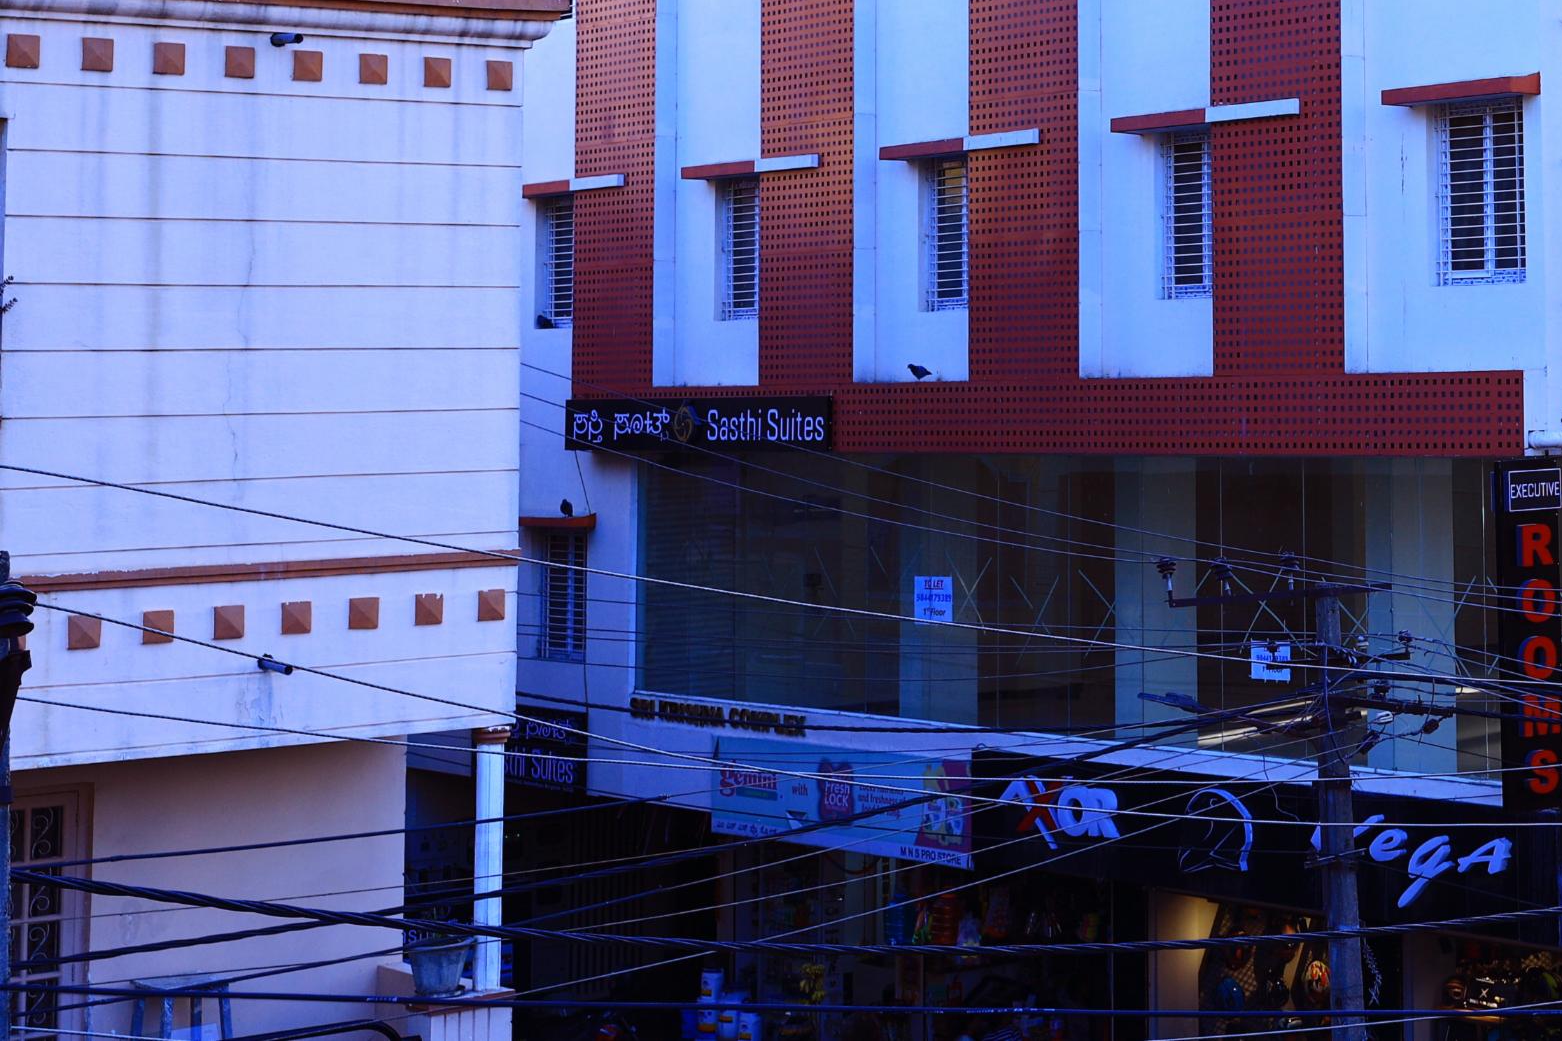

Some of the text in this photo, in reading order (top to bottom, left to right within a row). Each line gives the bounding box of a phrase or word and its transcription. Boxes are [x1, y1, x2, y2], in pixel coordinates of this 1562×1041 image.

[707, 409, 824, 441] Sasthi Suites
[1510, 481, 1560, 499] EXECUTIVE
[1517, 524, 1562, 794] ROOMS
[531, 748, 573, 783] Suites
[792, 783, 808, 796] with
[825, 793, 849, 807] LOCK
[1000, 775, 1121, 850] AXOR
